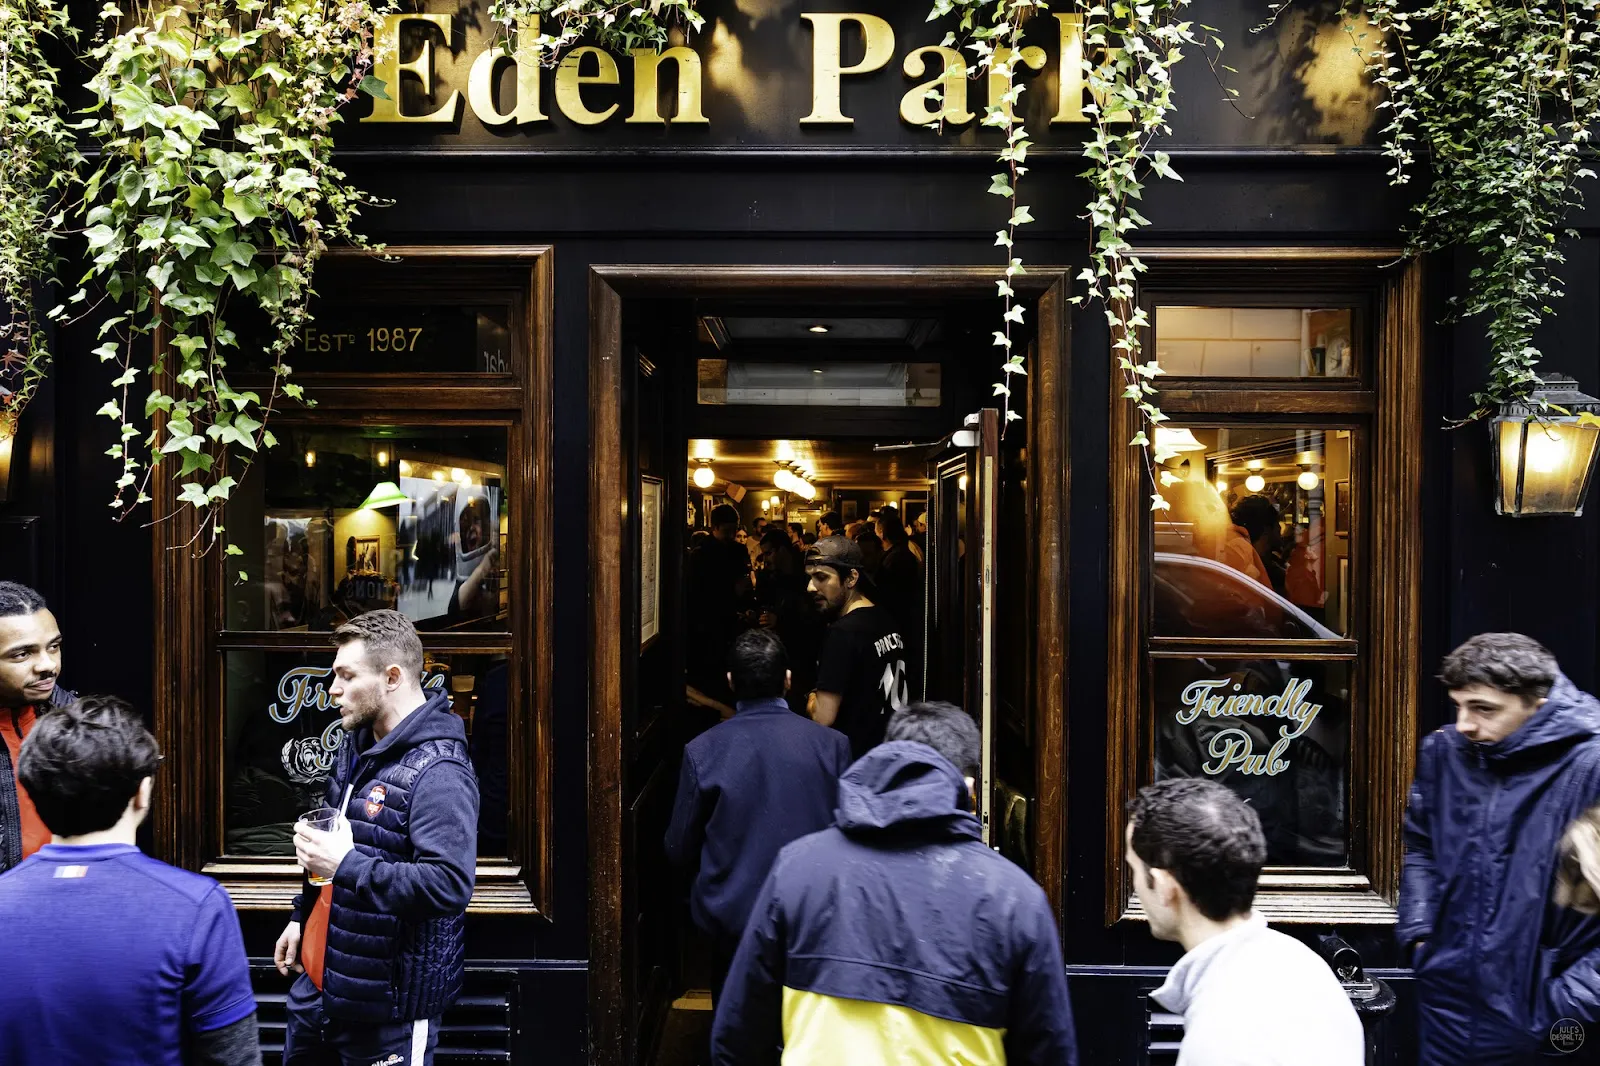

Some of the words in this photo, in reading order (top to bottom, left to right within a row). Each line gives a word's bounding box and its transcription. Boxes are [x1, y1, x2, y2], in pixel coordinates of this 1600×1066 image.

[360, 12, 709, 126] Eden
[799, 12, 1137, 127] Park
[367, 328, 423, 352] 1987
[1175, 677, 1324, 739] Friendly
[1202, 728, 1291, 776] Pub
